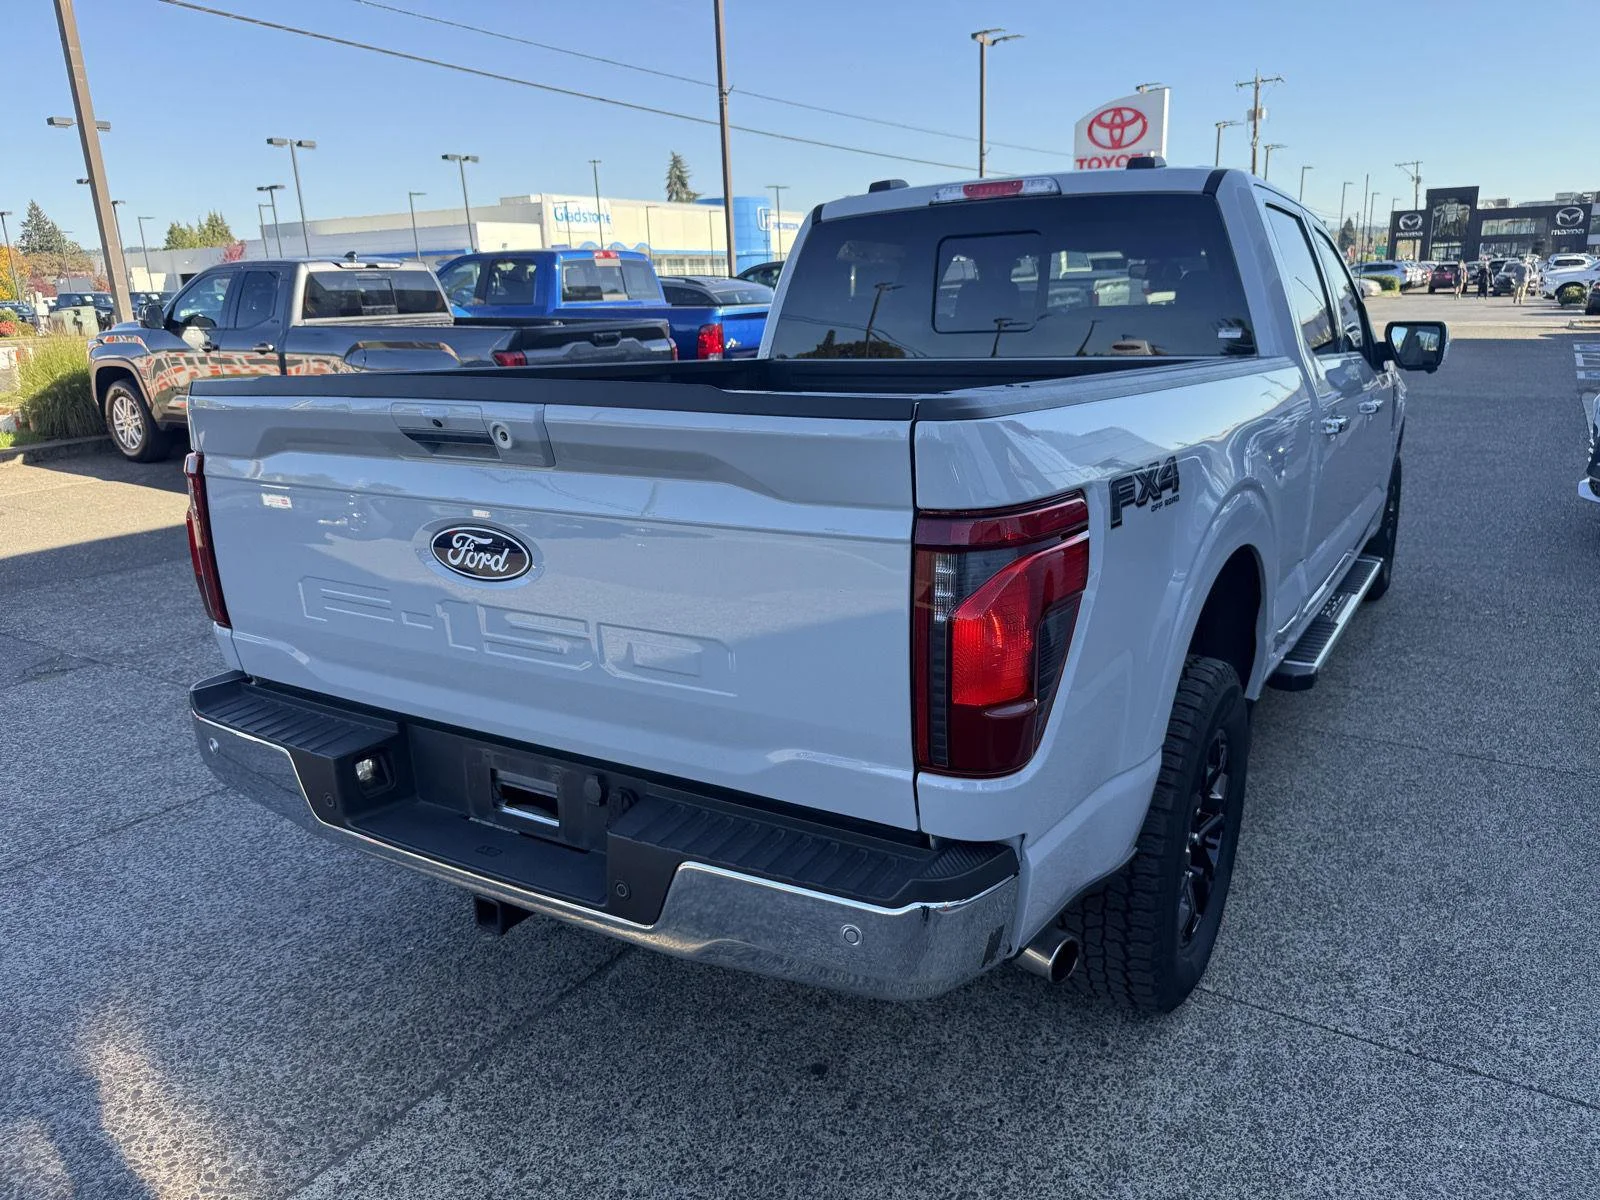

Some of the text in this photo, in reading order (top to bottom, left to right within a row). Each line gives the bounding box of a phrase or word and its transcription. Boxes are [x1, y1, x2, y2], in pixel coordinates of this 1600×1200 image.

[1075, 153, 1144, 169] TOYO
[553, 206, 611, 225] Gladstone
[1108, 455, 1180, 530] FX4
[1150, 494, 1180, 513] OFF ROAD
[447, 532, 510, 574] Ford
[297, 575, 739, 697] F-150
